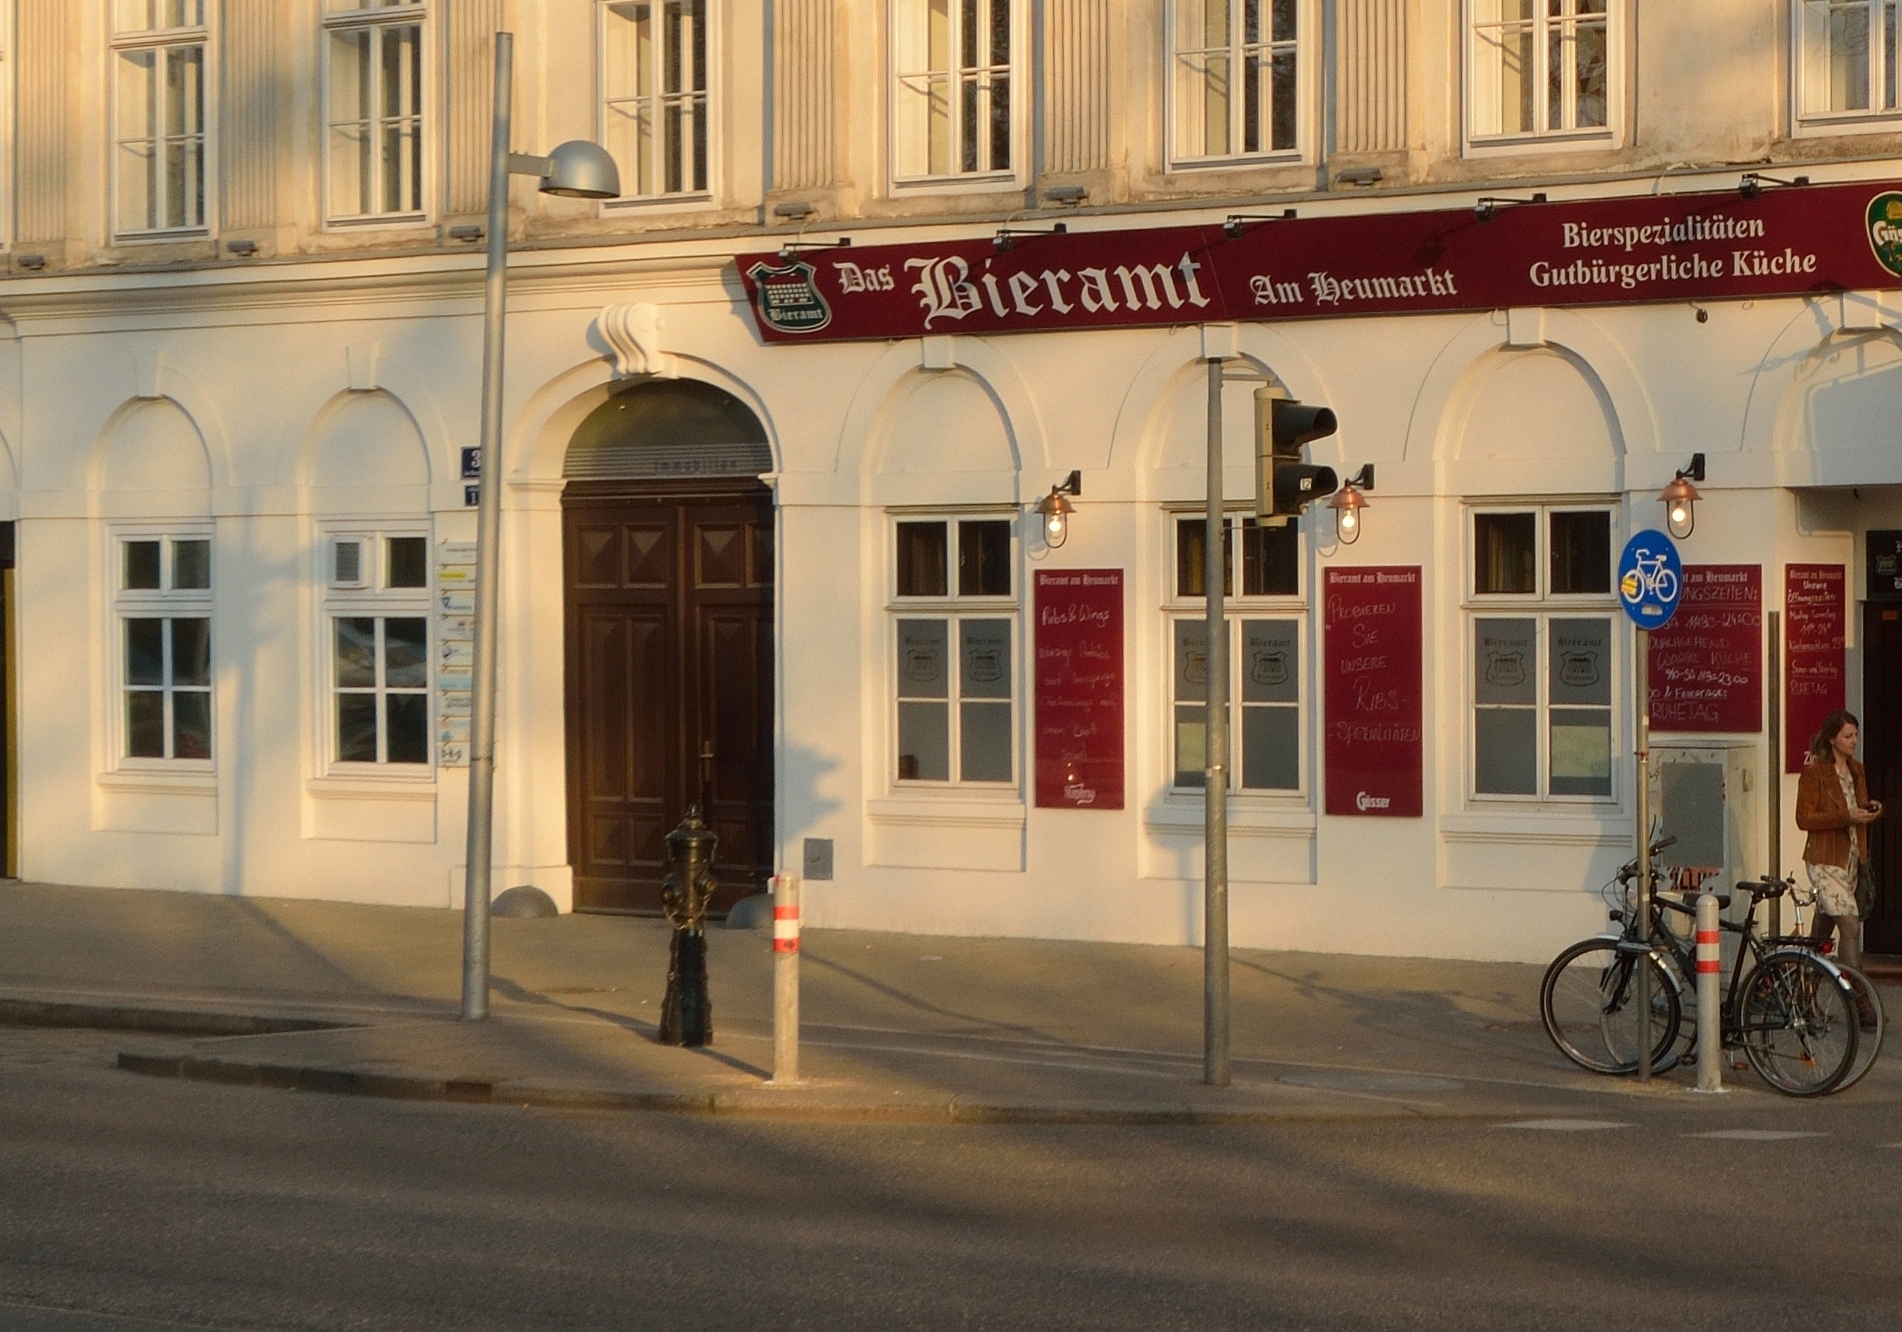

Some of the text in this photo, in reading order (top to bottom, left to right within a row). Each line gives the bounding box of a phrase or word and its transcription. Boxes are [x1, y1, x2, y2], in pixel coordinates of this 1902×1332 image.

[1562, 215, 1765, 252] Bierspezialitäten
[1529, 249, 1817, 289] Gutbürgerliche Küche
[833, 251, 1211, 329] Das Bieramt
[1249, 268, 1458, 306] Am Heumarkt
[766, 309, 823, 321] Bieramt
[1070, 577, 1081, 586] am
[1082, 574, 1119, 586] Heumarkt
[1329, 571, 1416, 584] Bieramt am Heumarkt
[1690, 573, 1703, 583] am
[1705, 571, 1748, 583] Heumarkt
[1250, 638, 1290, 647] Bieramt
[1483, 637, 1528, 647] Bieramt
[1558, 637, 1602, 647] Bieramt
[1651, 701, 1719, 722] RUHETAG
[1356, 791, 1391, 811] Gösser
